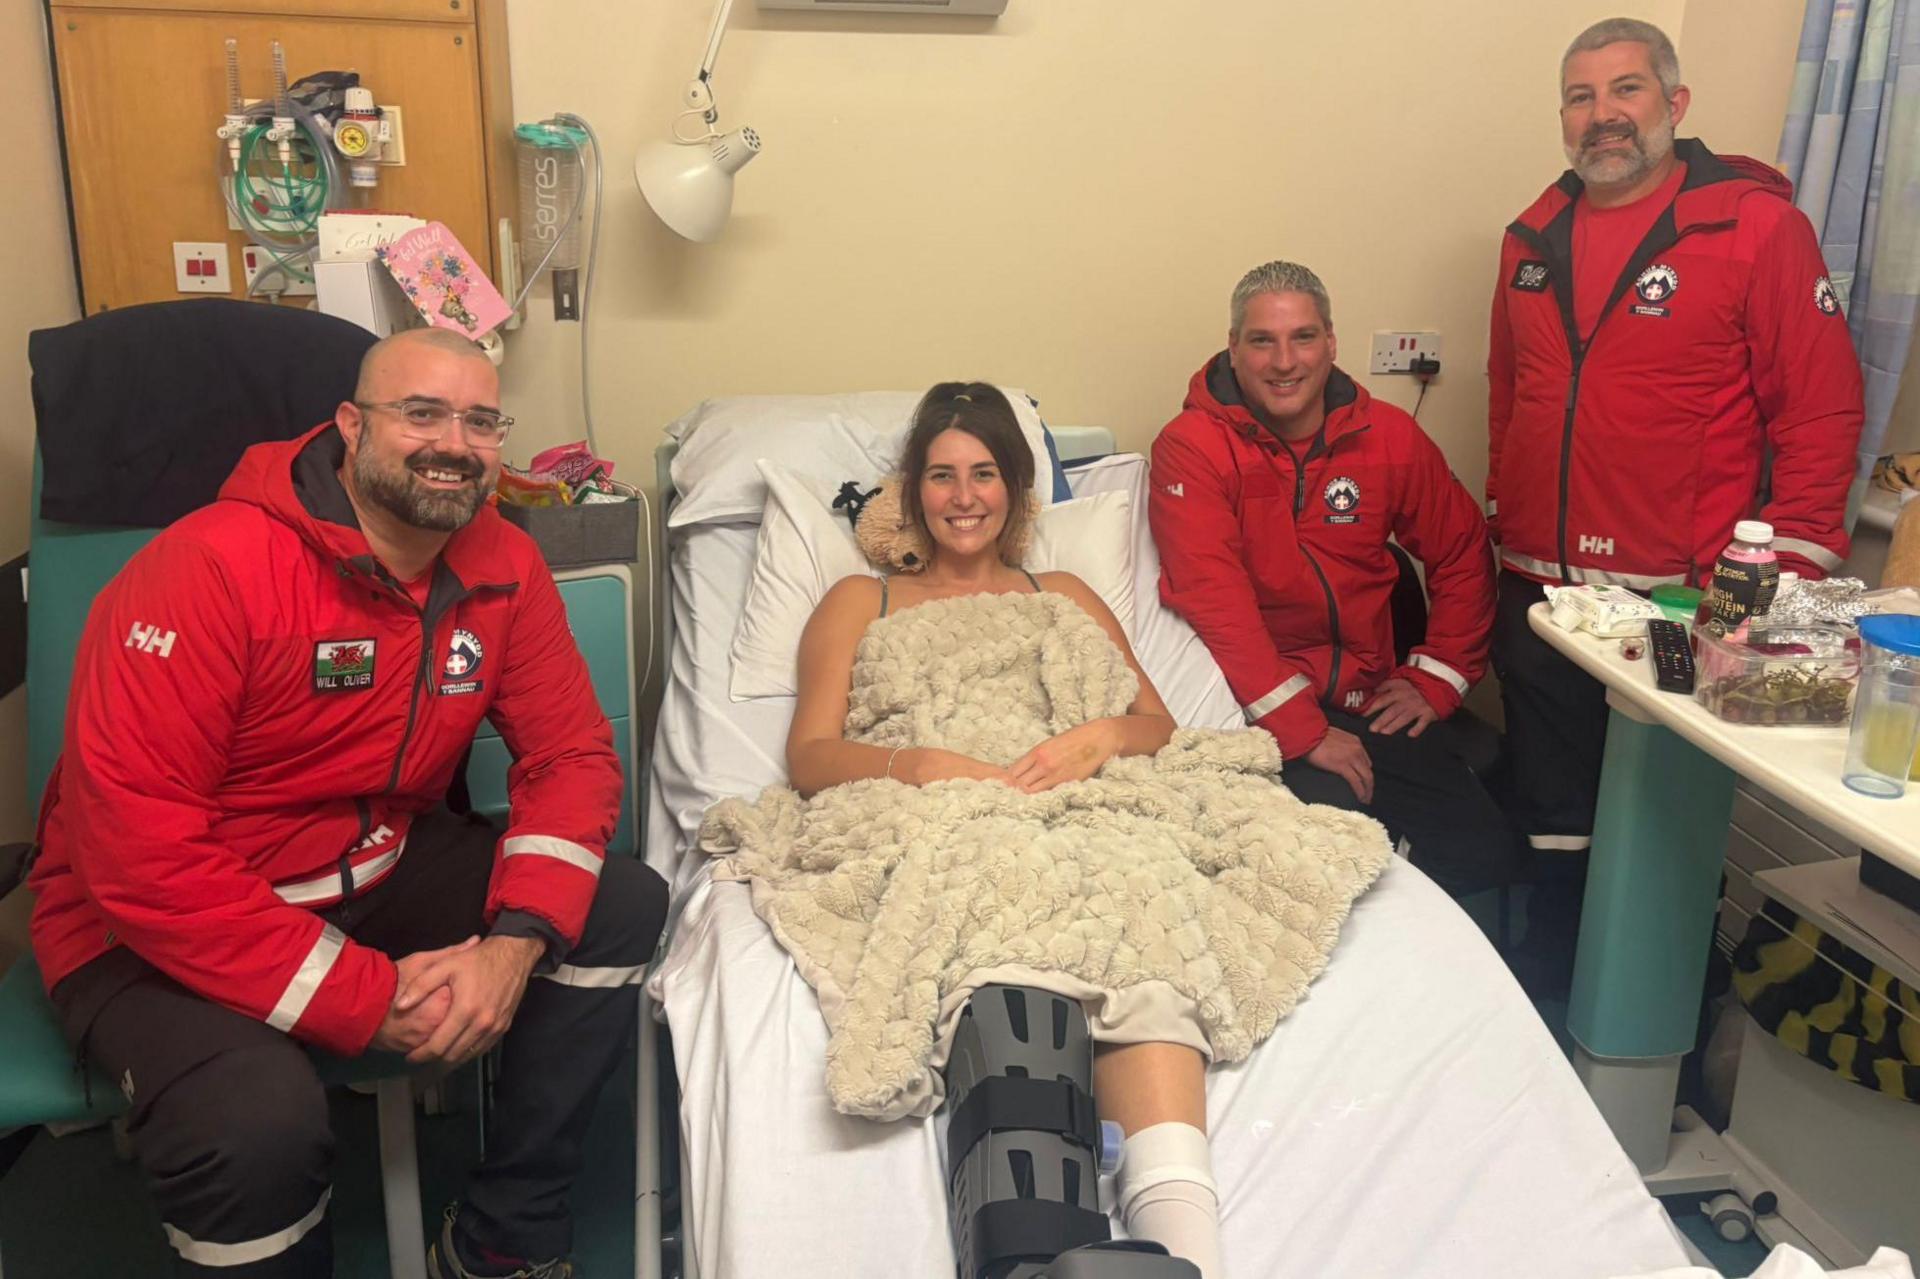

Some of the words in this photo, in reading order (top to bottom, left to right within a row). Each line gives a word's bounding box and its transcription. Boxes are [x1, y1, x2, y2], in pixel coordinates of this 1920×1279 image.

[535, 157, 557, 240] serres
[1579, 534, 1614, 555] HH
[124, 621, 177, 658] HH
[316, 676, 337, 689] WILL
[343, 673, 371, 687] OLIVER
